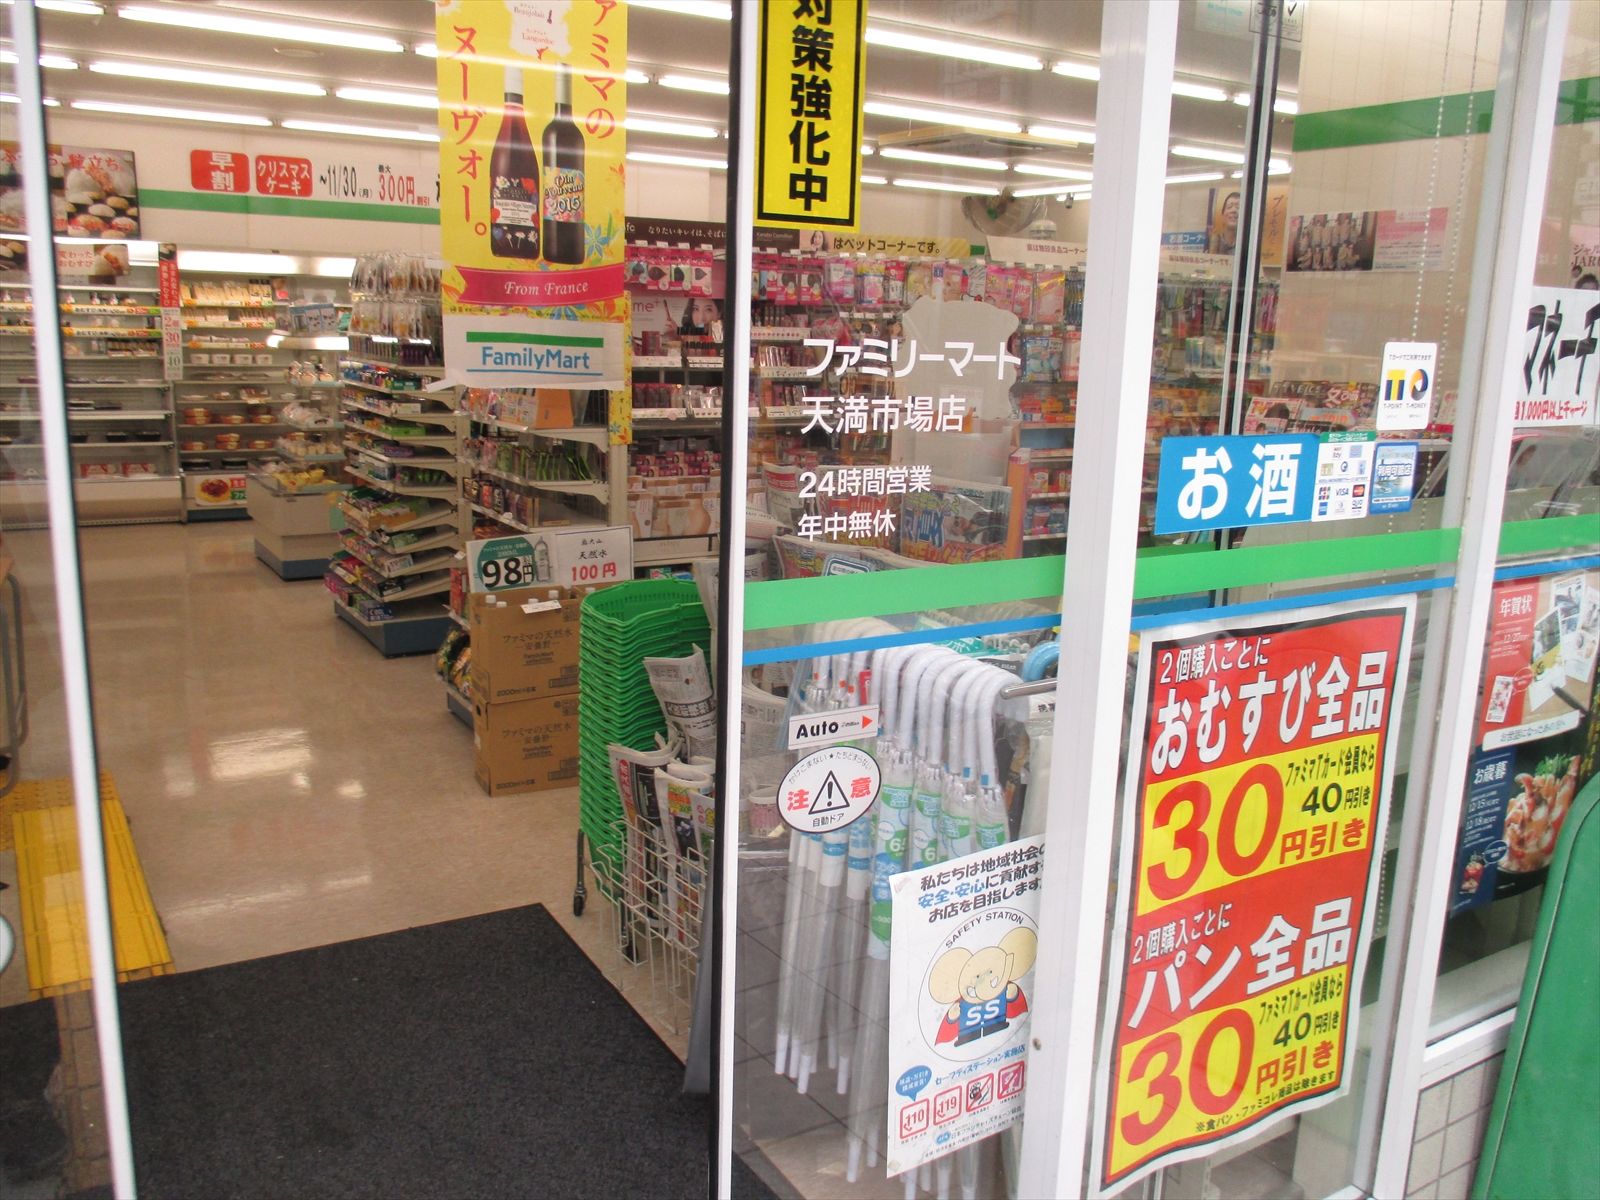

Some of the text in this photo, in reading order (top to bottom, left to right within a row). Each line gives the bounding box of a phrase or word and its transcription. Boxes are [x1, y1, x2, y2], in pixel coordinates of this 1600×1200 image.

[208, 152, 236, 192] 早割
[257, 160, 311, 180] クリスマス
[265, 177, 302, 195] ケーキ
[504, 281, 589, 296] From France
[481, 346, 590, 370] FamilyMart
[803, 338, 1022, 381] ファミリーマート
[800, 394, 967, 435] 天満市場店
[797, 464, 933, 499] 24時間営業
[1176, 442, 1303, 521] お酒
[796, 508, 898, 542] 年中無休
[571, 562, 617, 582] 100円
[577, 549, 608, 561] 天然水
[1499, 594, 1533, 618] 年賀状
[1159, 636, 1273, 685] 2個購入ごとに
[796, 721, 839, 739] Auto
[1151, 650, 1388, 775] おむすび全品
[1286, 744, 1376, 788] ファミマTカード会員なら
[1473, 760, 1509, 785] お歳暮
[786, 777, 872, 812] 注 意
[812, 812, 845, 828] 自動ドア
[917, 860, 1045, 910] 安全・安心に貢献す
[945, 910, 1024, 949] SAFETY STATION
[1131, 902, 1233, 965] 2個購入ごとに
[1127, 896, 1353, 1030] パン全品
